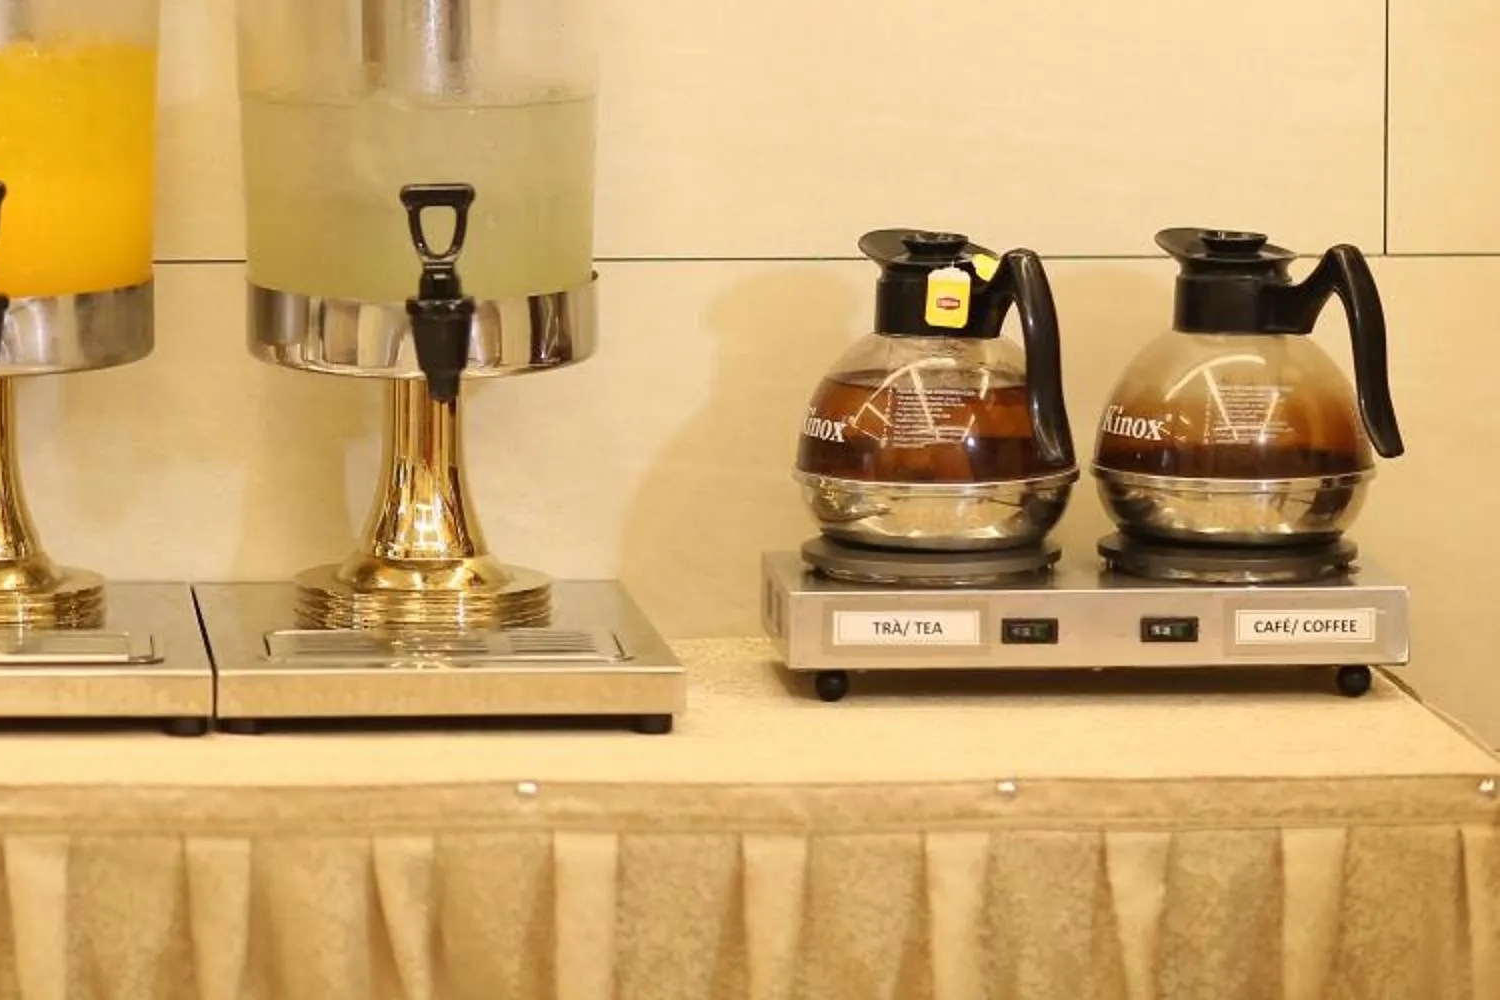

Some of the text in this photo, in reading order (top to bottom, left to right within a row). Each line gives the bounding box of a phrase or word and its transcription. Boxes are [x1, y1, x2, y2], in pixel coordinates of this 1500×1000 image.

[1102, 404, 1164, 441] Kinox
[873, 618, 943, 637] TRÀ/ TEA
[1253, 617, 1358, 637] CAFÉ/ COFFEE
